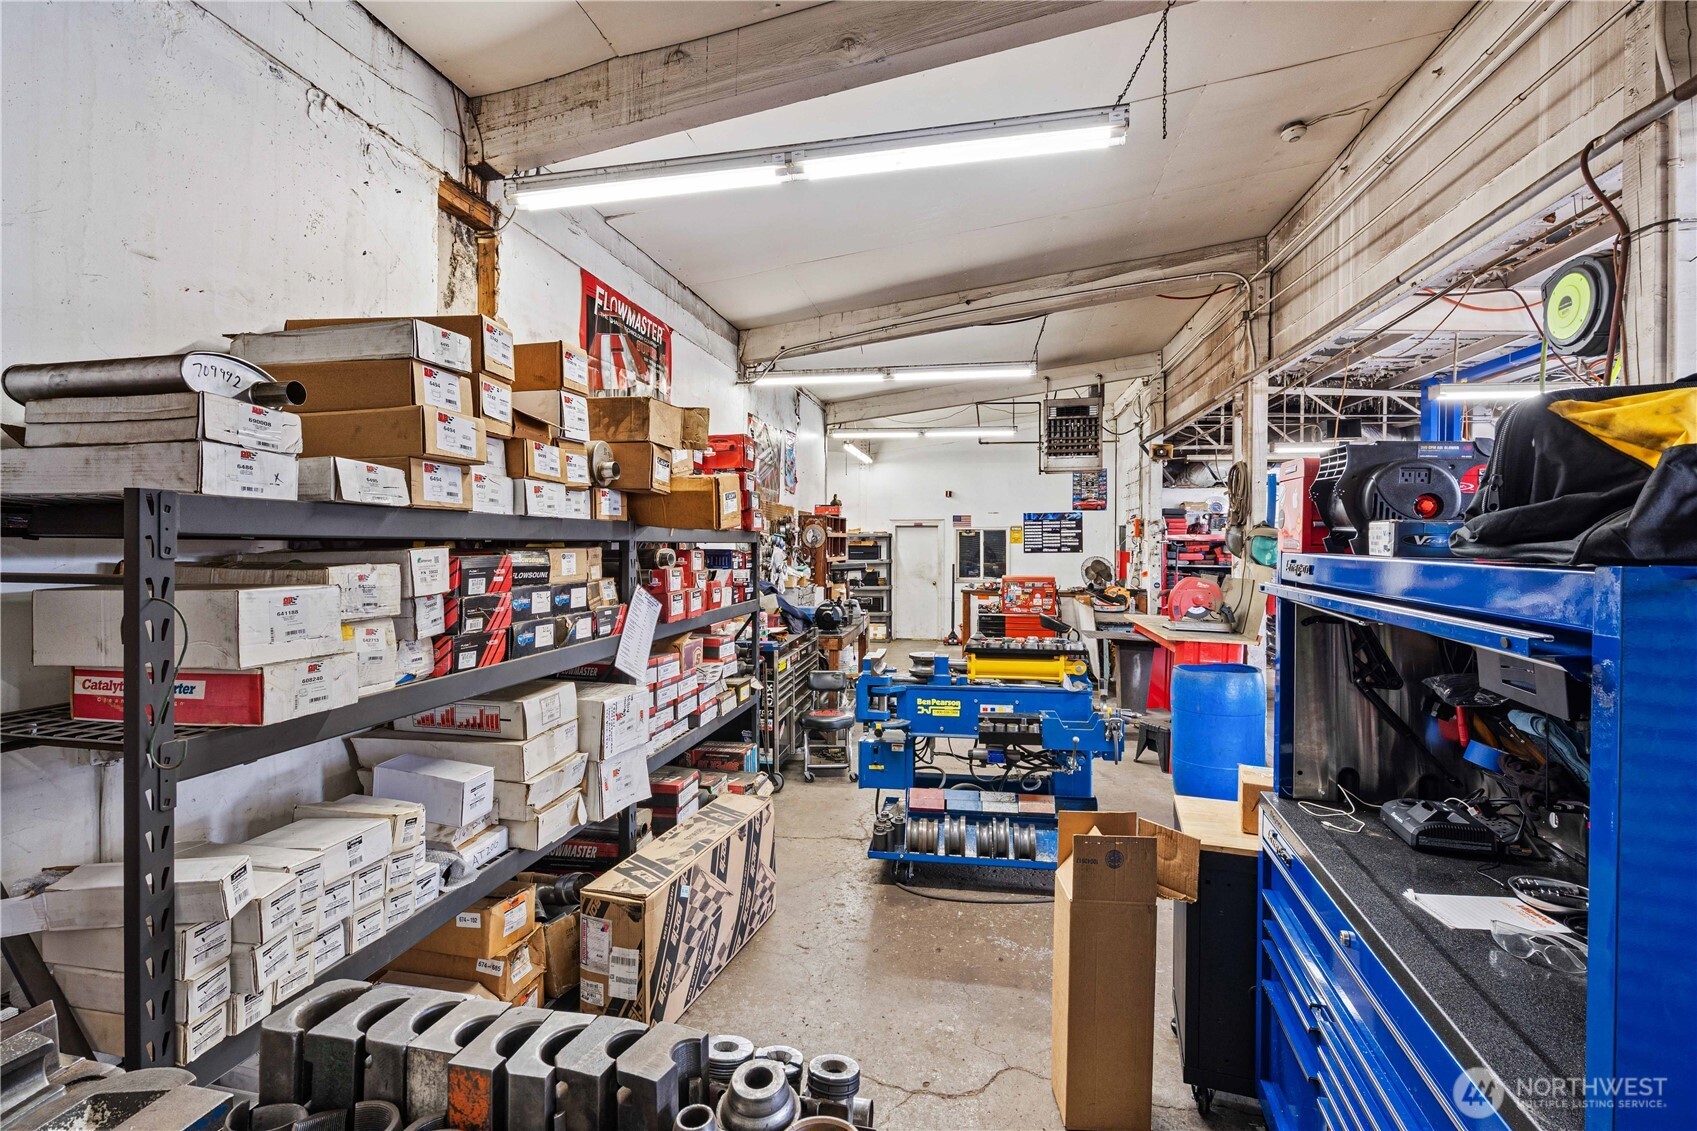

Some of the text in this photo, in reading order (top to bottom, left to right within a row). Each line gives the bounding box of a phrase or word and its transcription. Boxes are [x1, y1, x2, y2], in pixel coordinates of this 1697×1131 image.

[594, 285, 663, 345] FLOWMASTER
[81, 678, 124, 694] Catalyt
[916, 697, 961, 708] Ben Pearson
